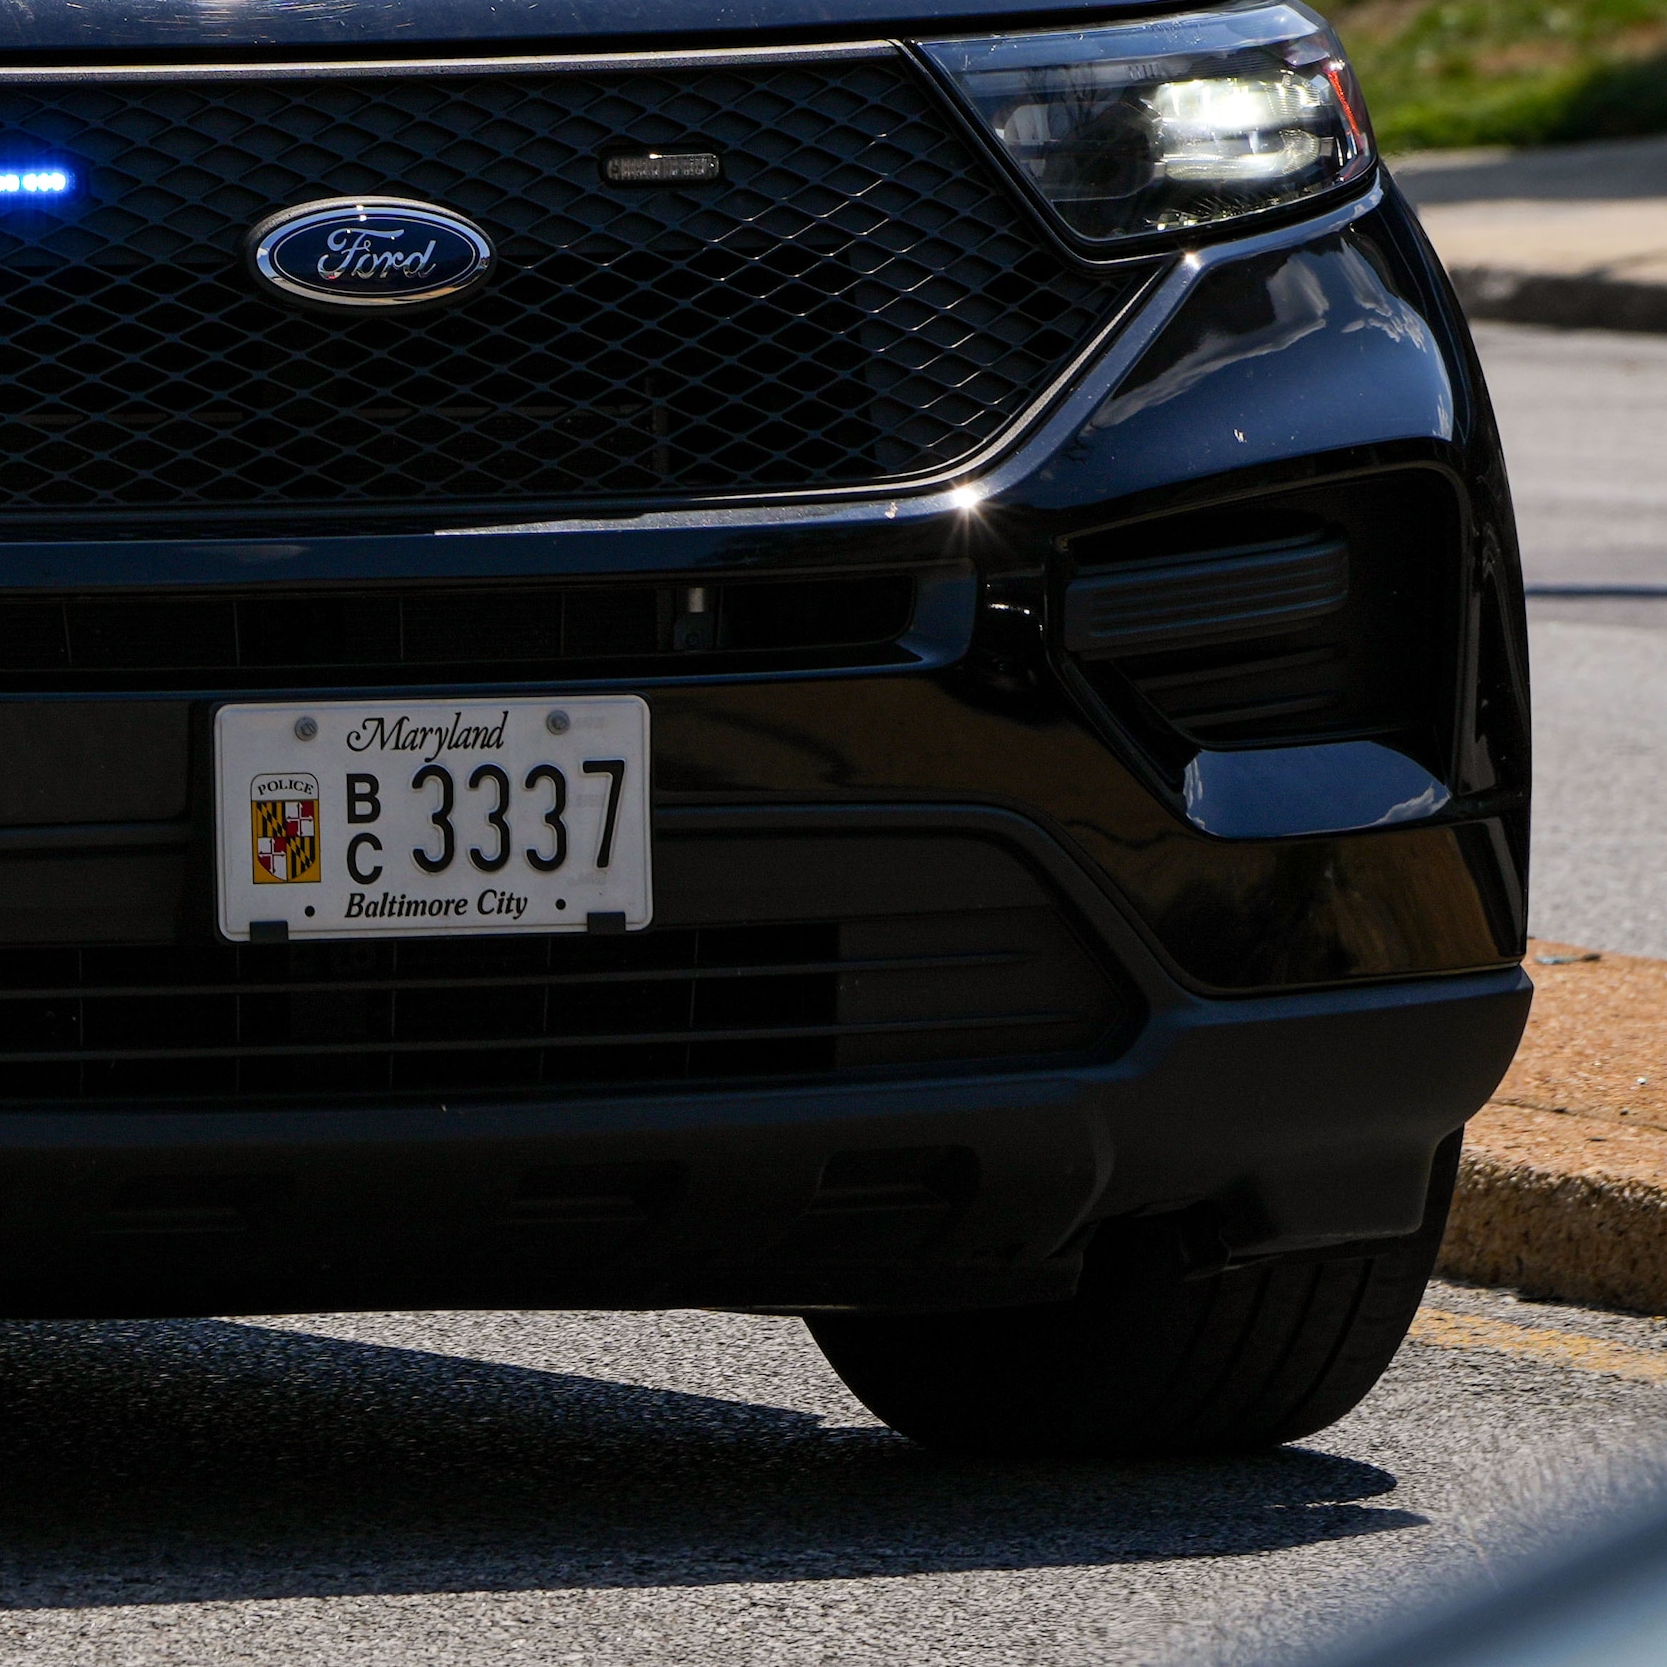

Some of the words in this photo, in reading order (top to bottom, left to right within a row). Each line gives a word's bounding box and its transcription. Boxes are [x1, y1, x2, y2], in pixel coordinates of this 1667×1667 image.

[315, 226, 438, 281] Ford
[346, 710, 509, 764] Maryland
[257, 779, 315, 796] POLICE
[346, 772, 382, 825] B
[410, 758, 627, 874] 3337
[346, 832, 384, 886] C
[344, 892, 469, 920] Baltimore
[476, 889, 530, 922] City
